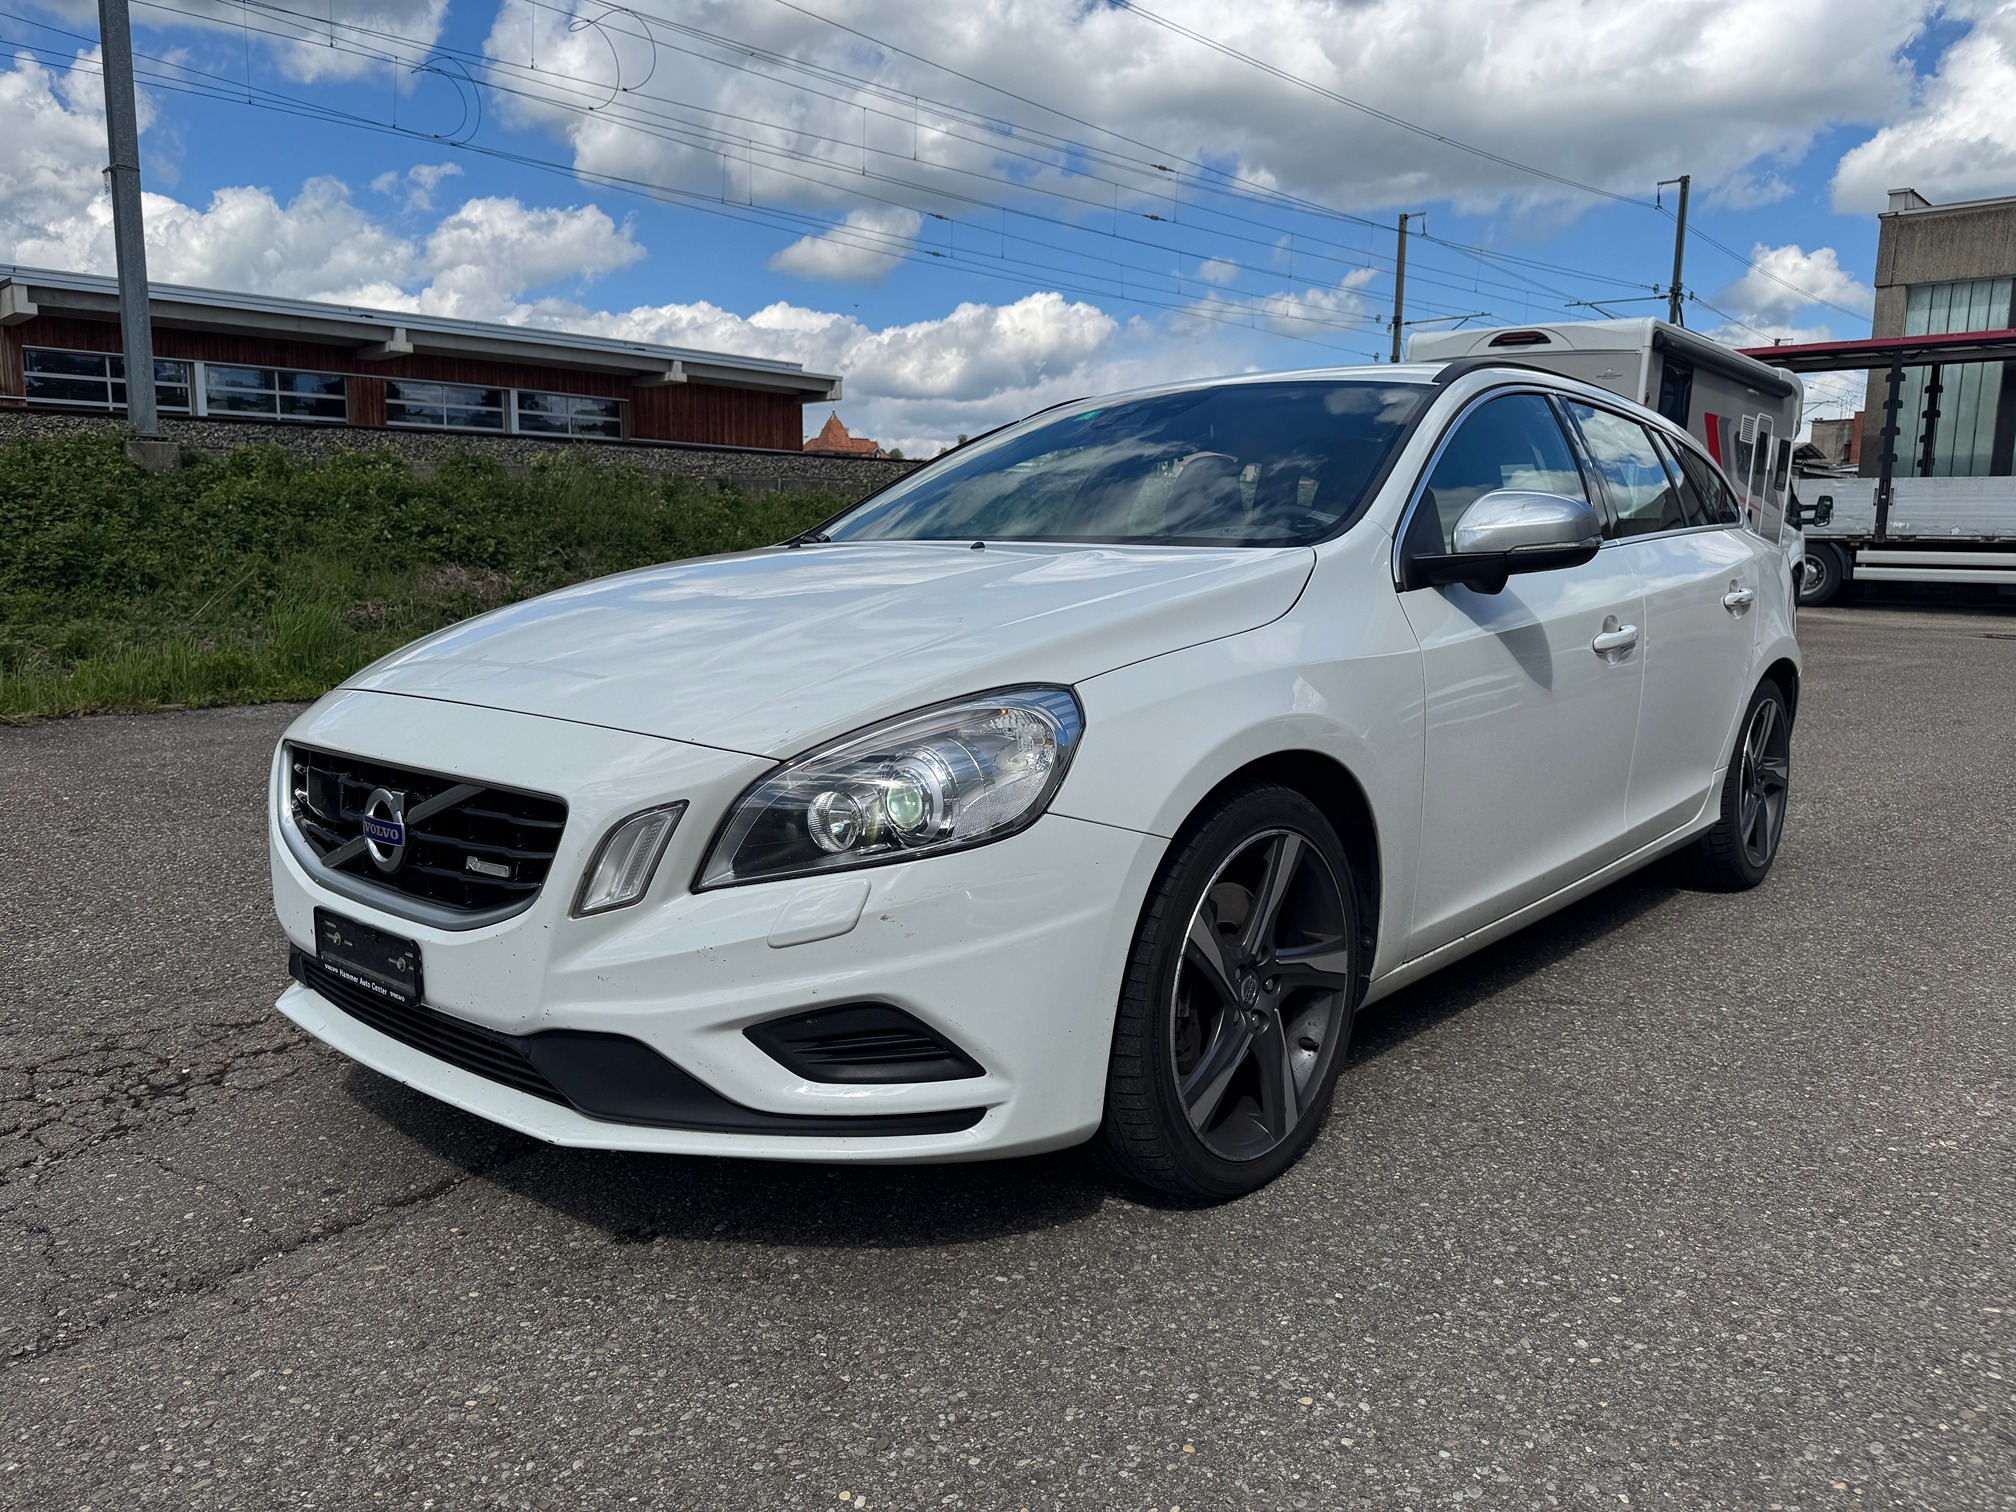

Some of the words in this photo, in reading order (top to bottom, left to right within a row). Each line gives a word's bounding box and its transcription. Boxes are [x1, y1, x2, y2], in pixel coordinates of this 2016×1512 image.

[365, 822, 399, 840] VOLVO
[339, 968, 359, 983] Hammer
[359, 977, 371, 989] Auto
[371, 982, 388, 996] Center
